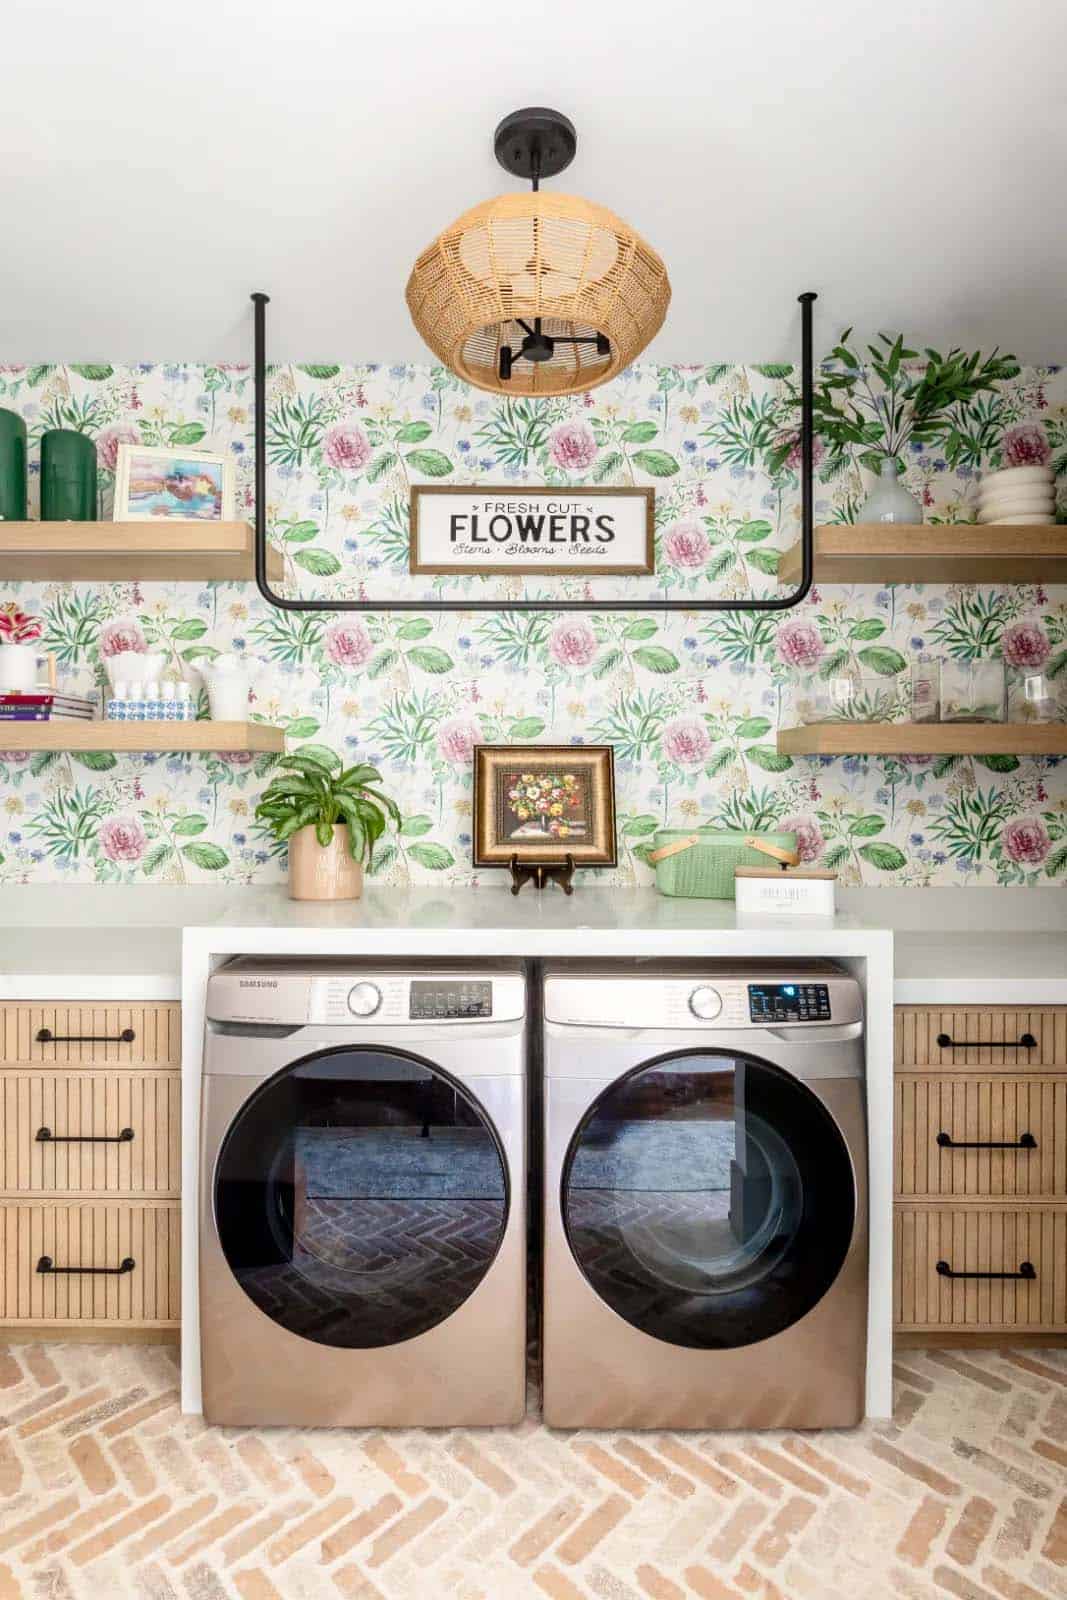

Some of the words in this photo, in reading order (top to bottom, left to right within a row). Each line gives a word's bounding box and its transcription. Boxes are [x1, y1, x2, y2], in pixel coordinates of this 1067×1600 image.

[484, 502, 540, 514] FRESH
[546, 502, 581, 514] CUT
[450, 514, 616, 543] FLOWERS
[453, 543, 492, 554] Stems
[504, 543, 557, 555] Blooms
[567, 543, 608, 554] Seeds
[239, 980, 278, 988] SAMSUNG
